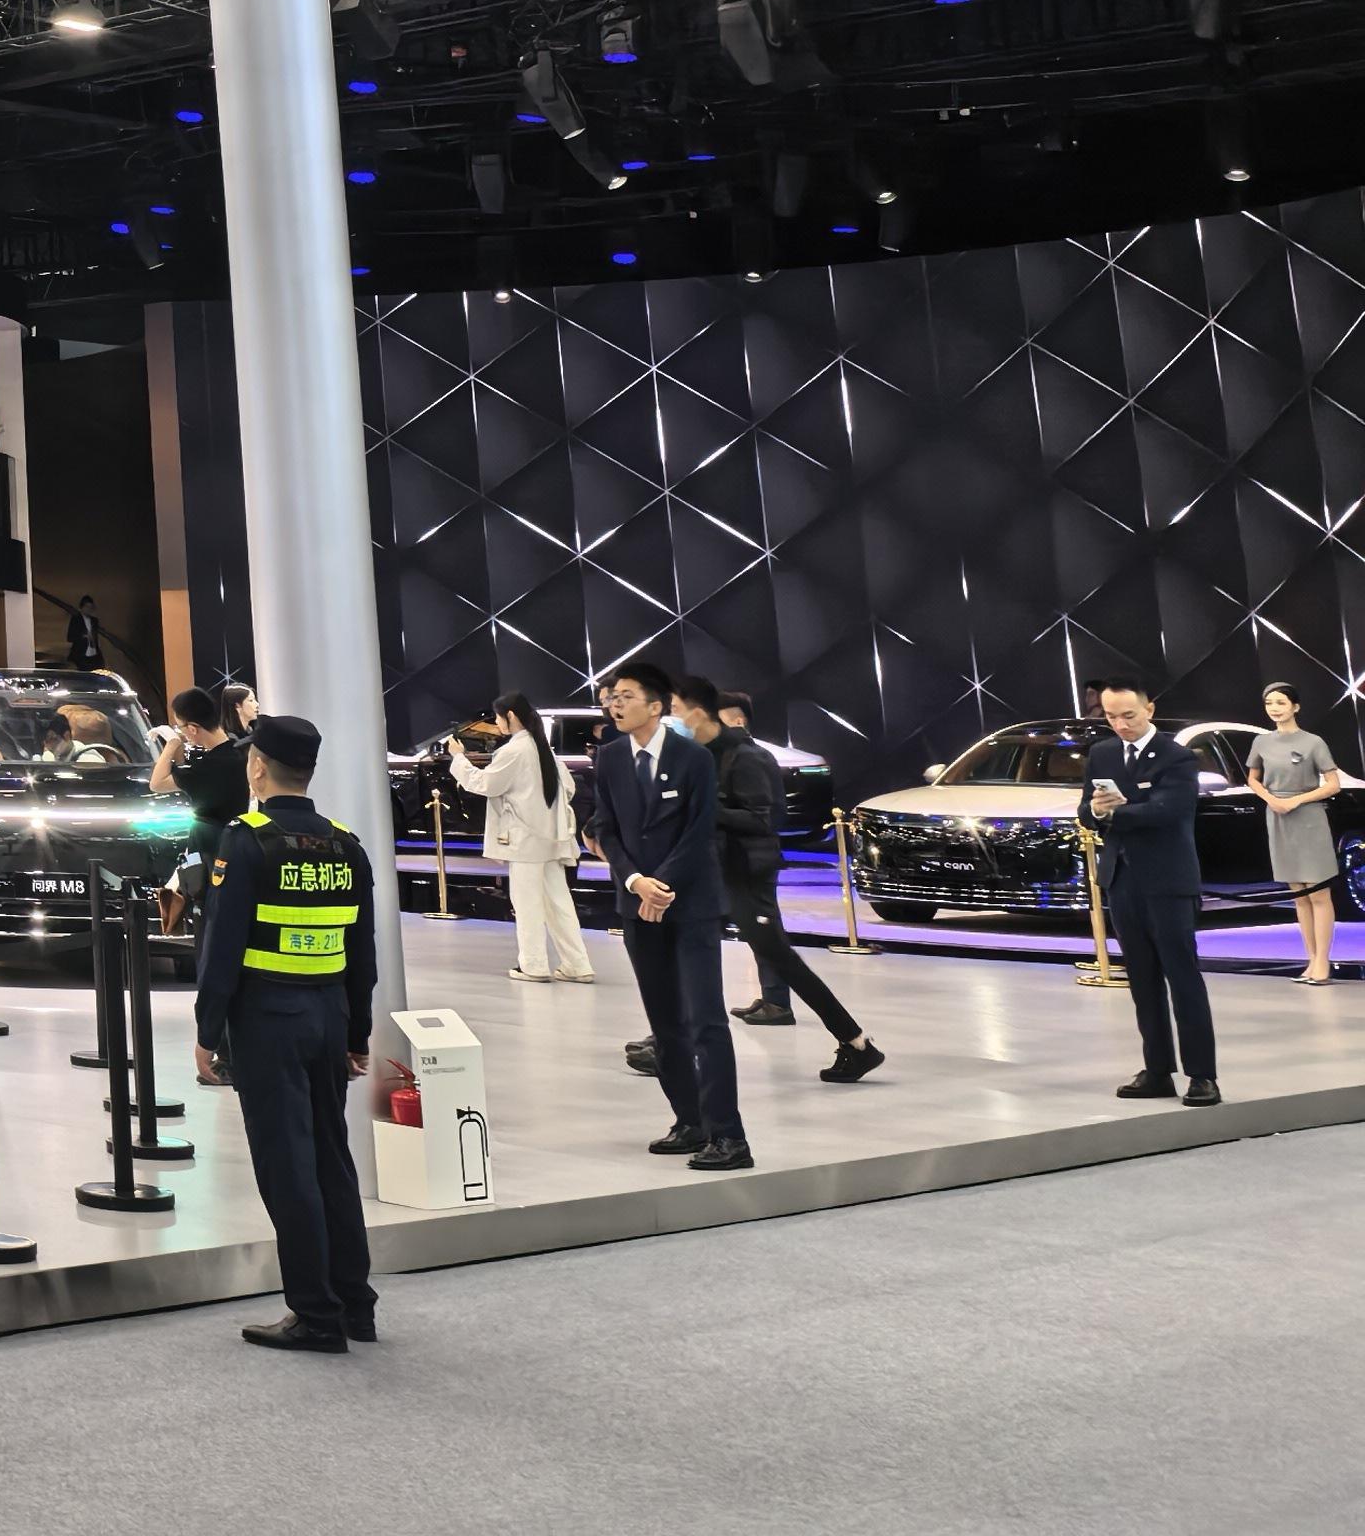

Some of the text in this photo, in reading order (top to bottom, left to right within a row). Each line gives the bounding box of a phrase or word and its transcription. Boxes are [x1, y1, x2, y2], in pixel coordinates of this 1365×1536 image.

[32, 878, 85, 894] 问界 M8
[280, 862, 353, 892] 应急机动
